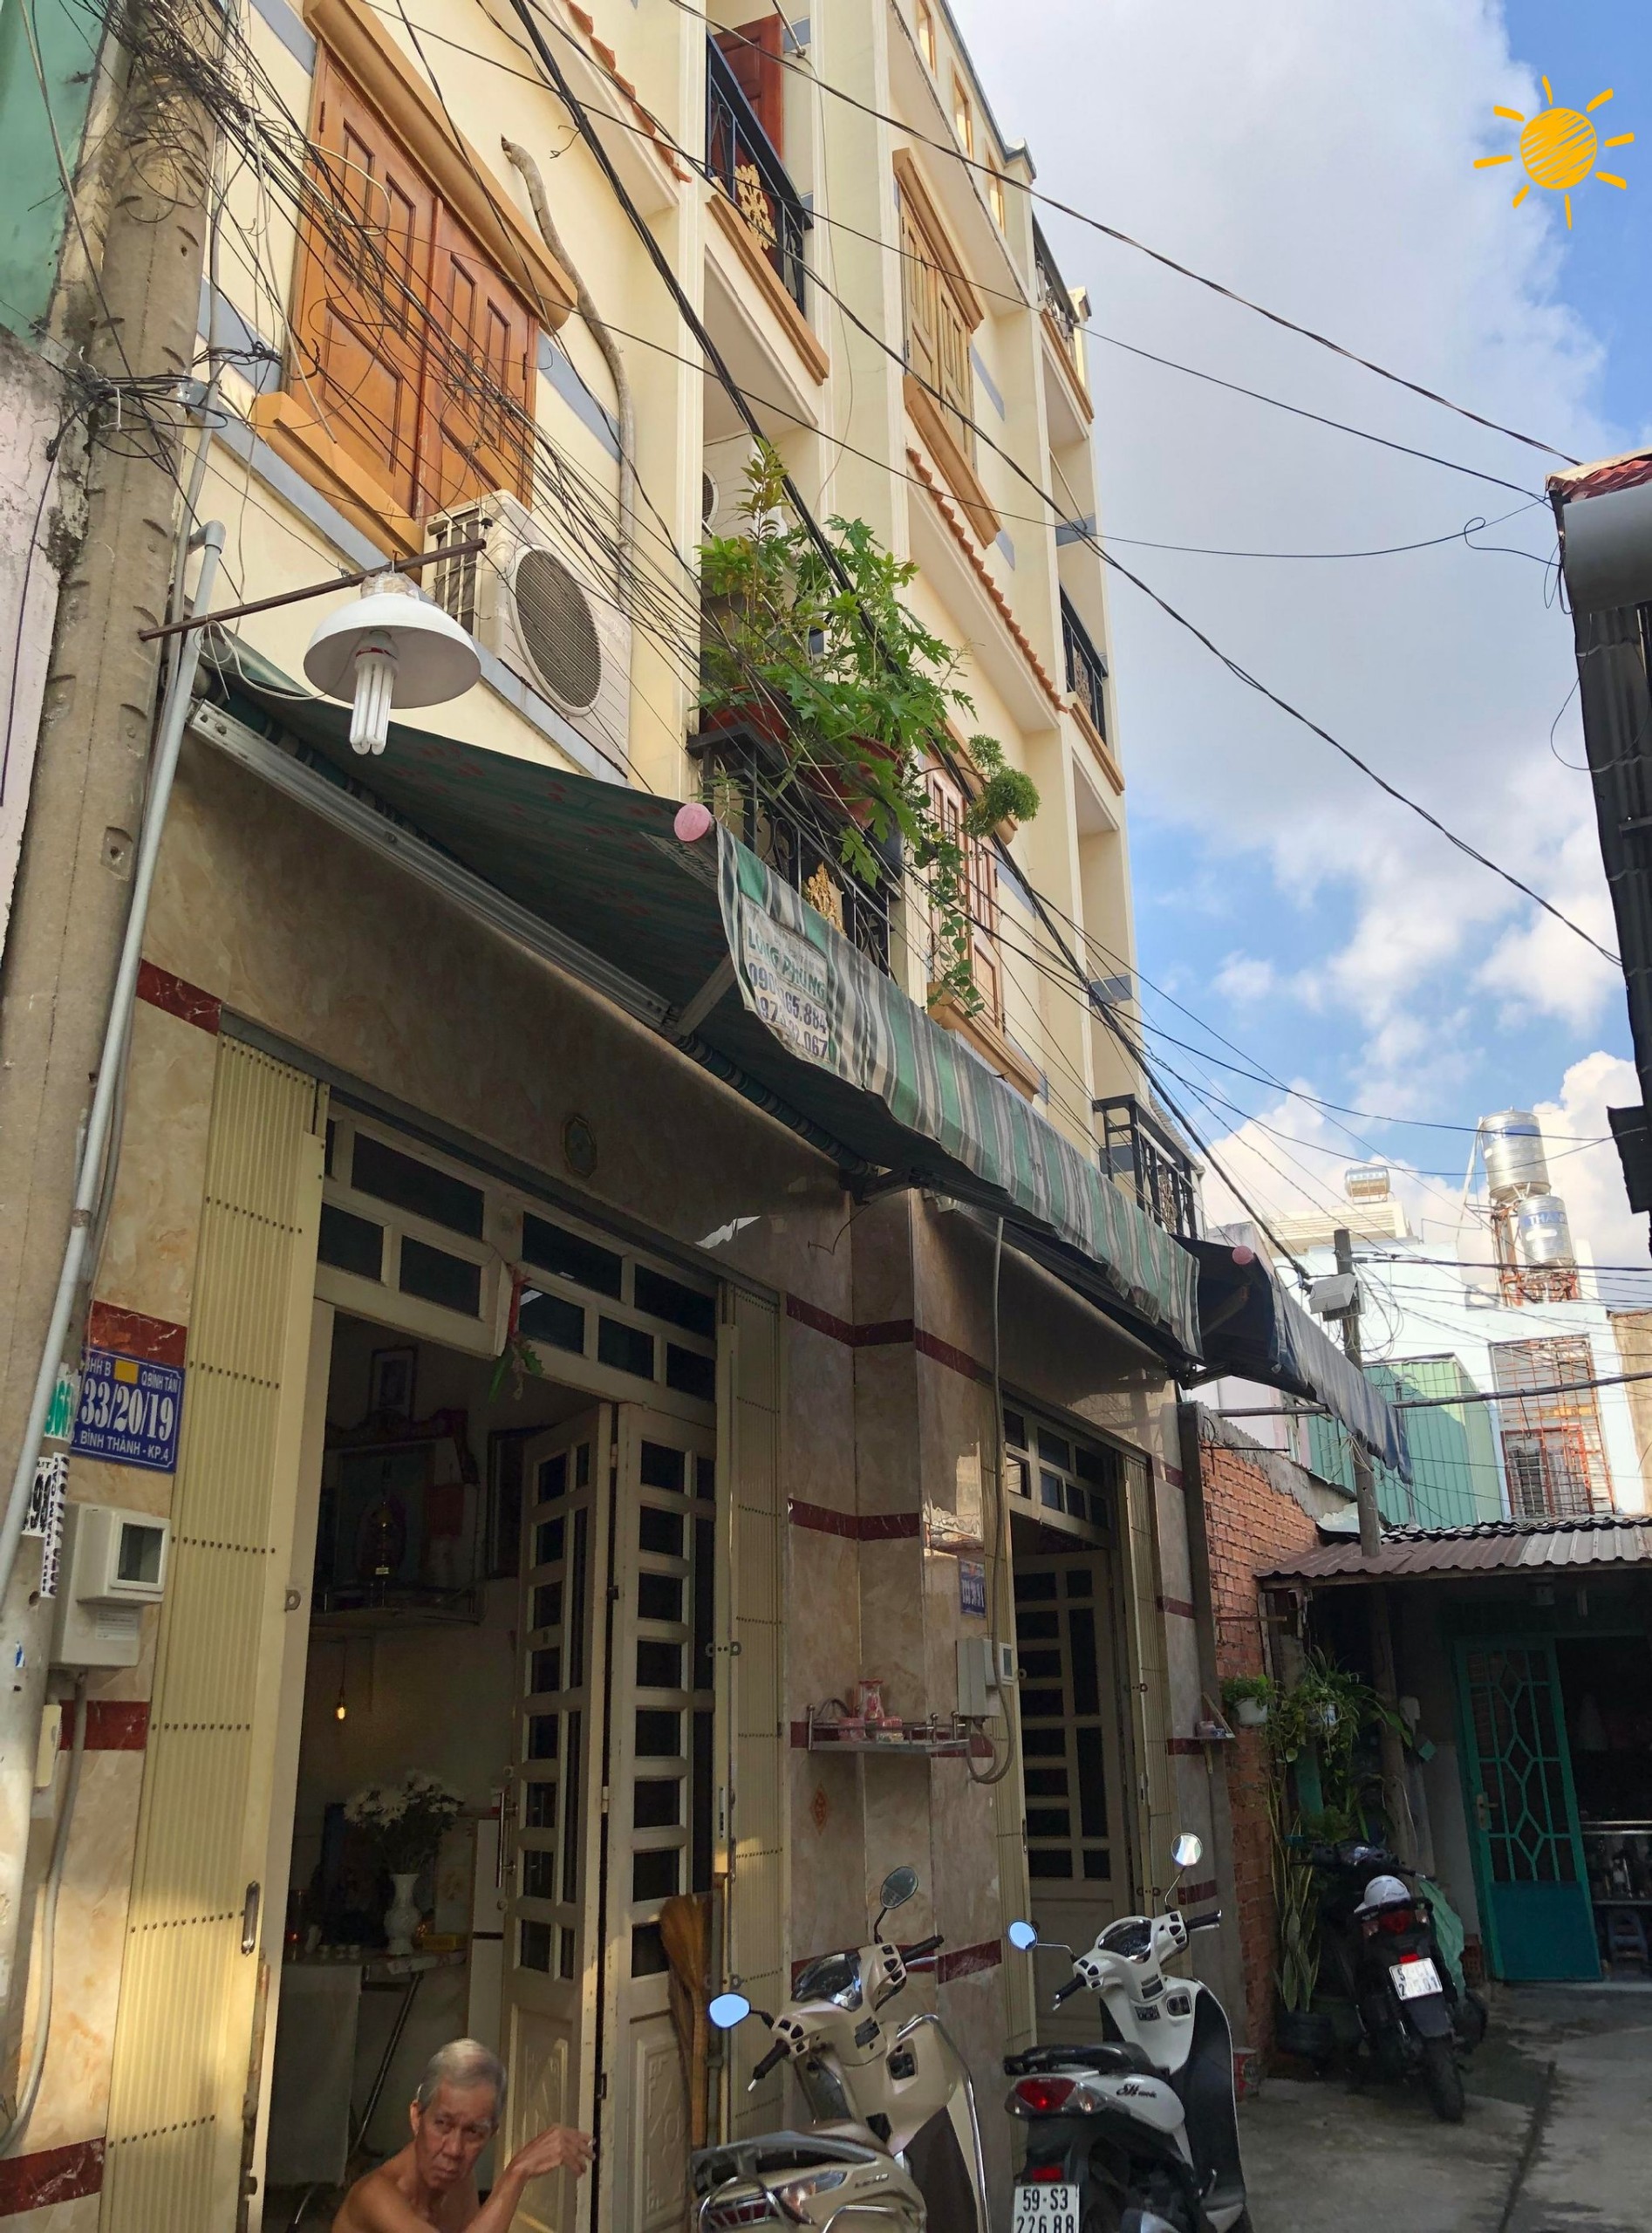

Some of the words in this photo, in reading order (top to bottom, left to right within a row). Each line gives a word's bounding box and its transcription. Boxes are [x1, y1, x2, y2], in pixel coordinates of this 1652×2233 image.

[104, 1361, 112, 1376] B
[75, 1378, 174, 1442] 33/20/19
[80, 1428, 104, 1449] BÌNH
[106, 1435, 141, 1456] THÀNH
